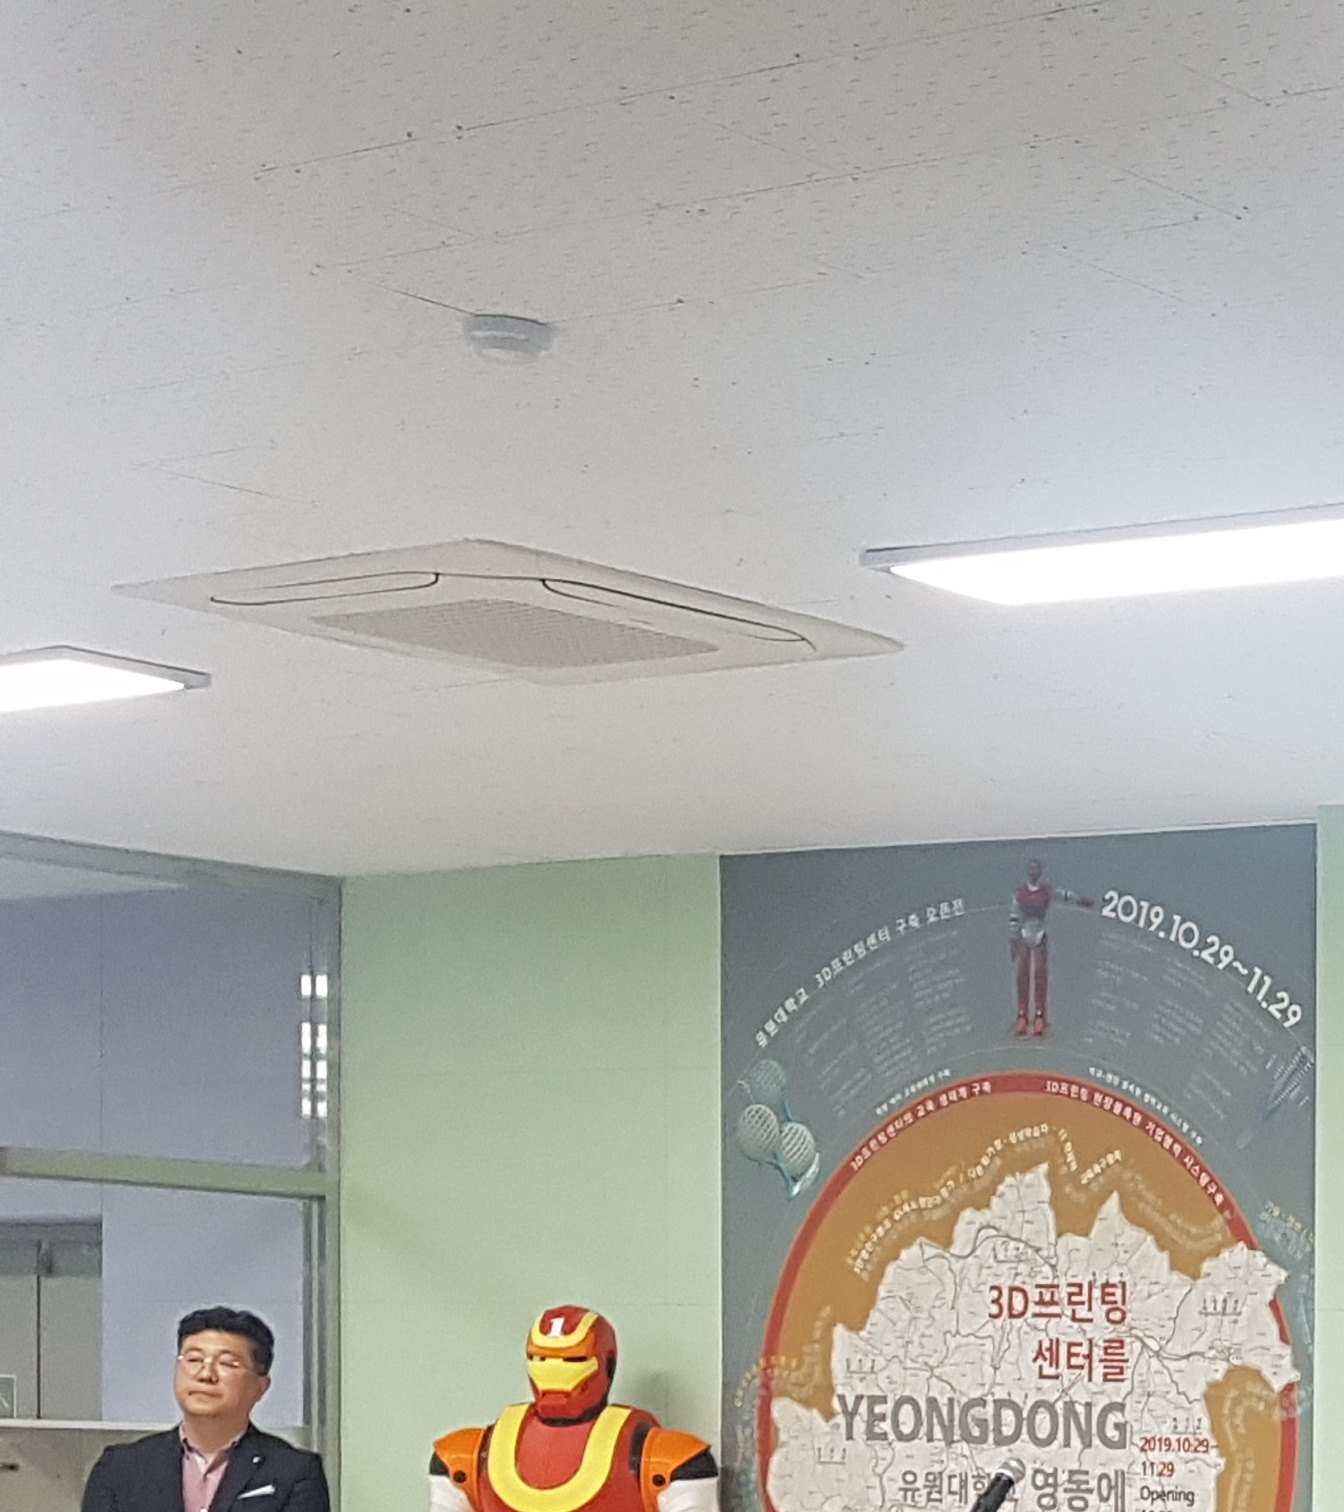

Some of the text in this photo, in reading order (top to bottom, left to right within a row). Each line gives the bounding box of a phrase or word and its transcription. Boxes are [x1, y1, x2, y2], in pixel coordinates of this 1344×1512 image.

[1101, 890, 1302, 1029] 2019.10.29~11.29
[988, 1280, 1128, 1326] 3D프린팅
[1032, 1337, 1129, 1383] 센터를
[837, 1394, 1128, 1451] YEONGDONG
[898, 1469, 1016, 1506] 유원대학
[1140, 1485, 1195, 1507] Opening
